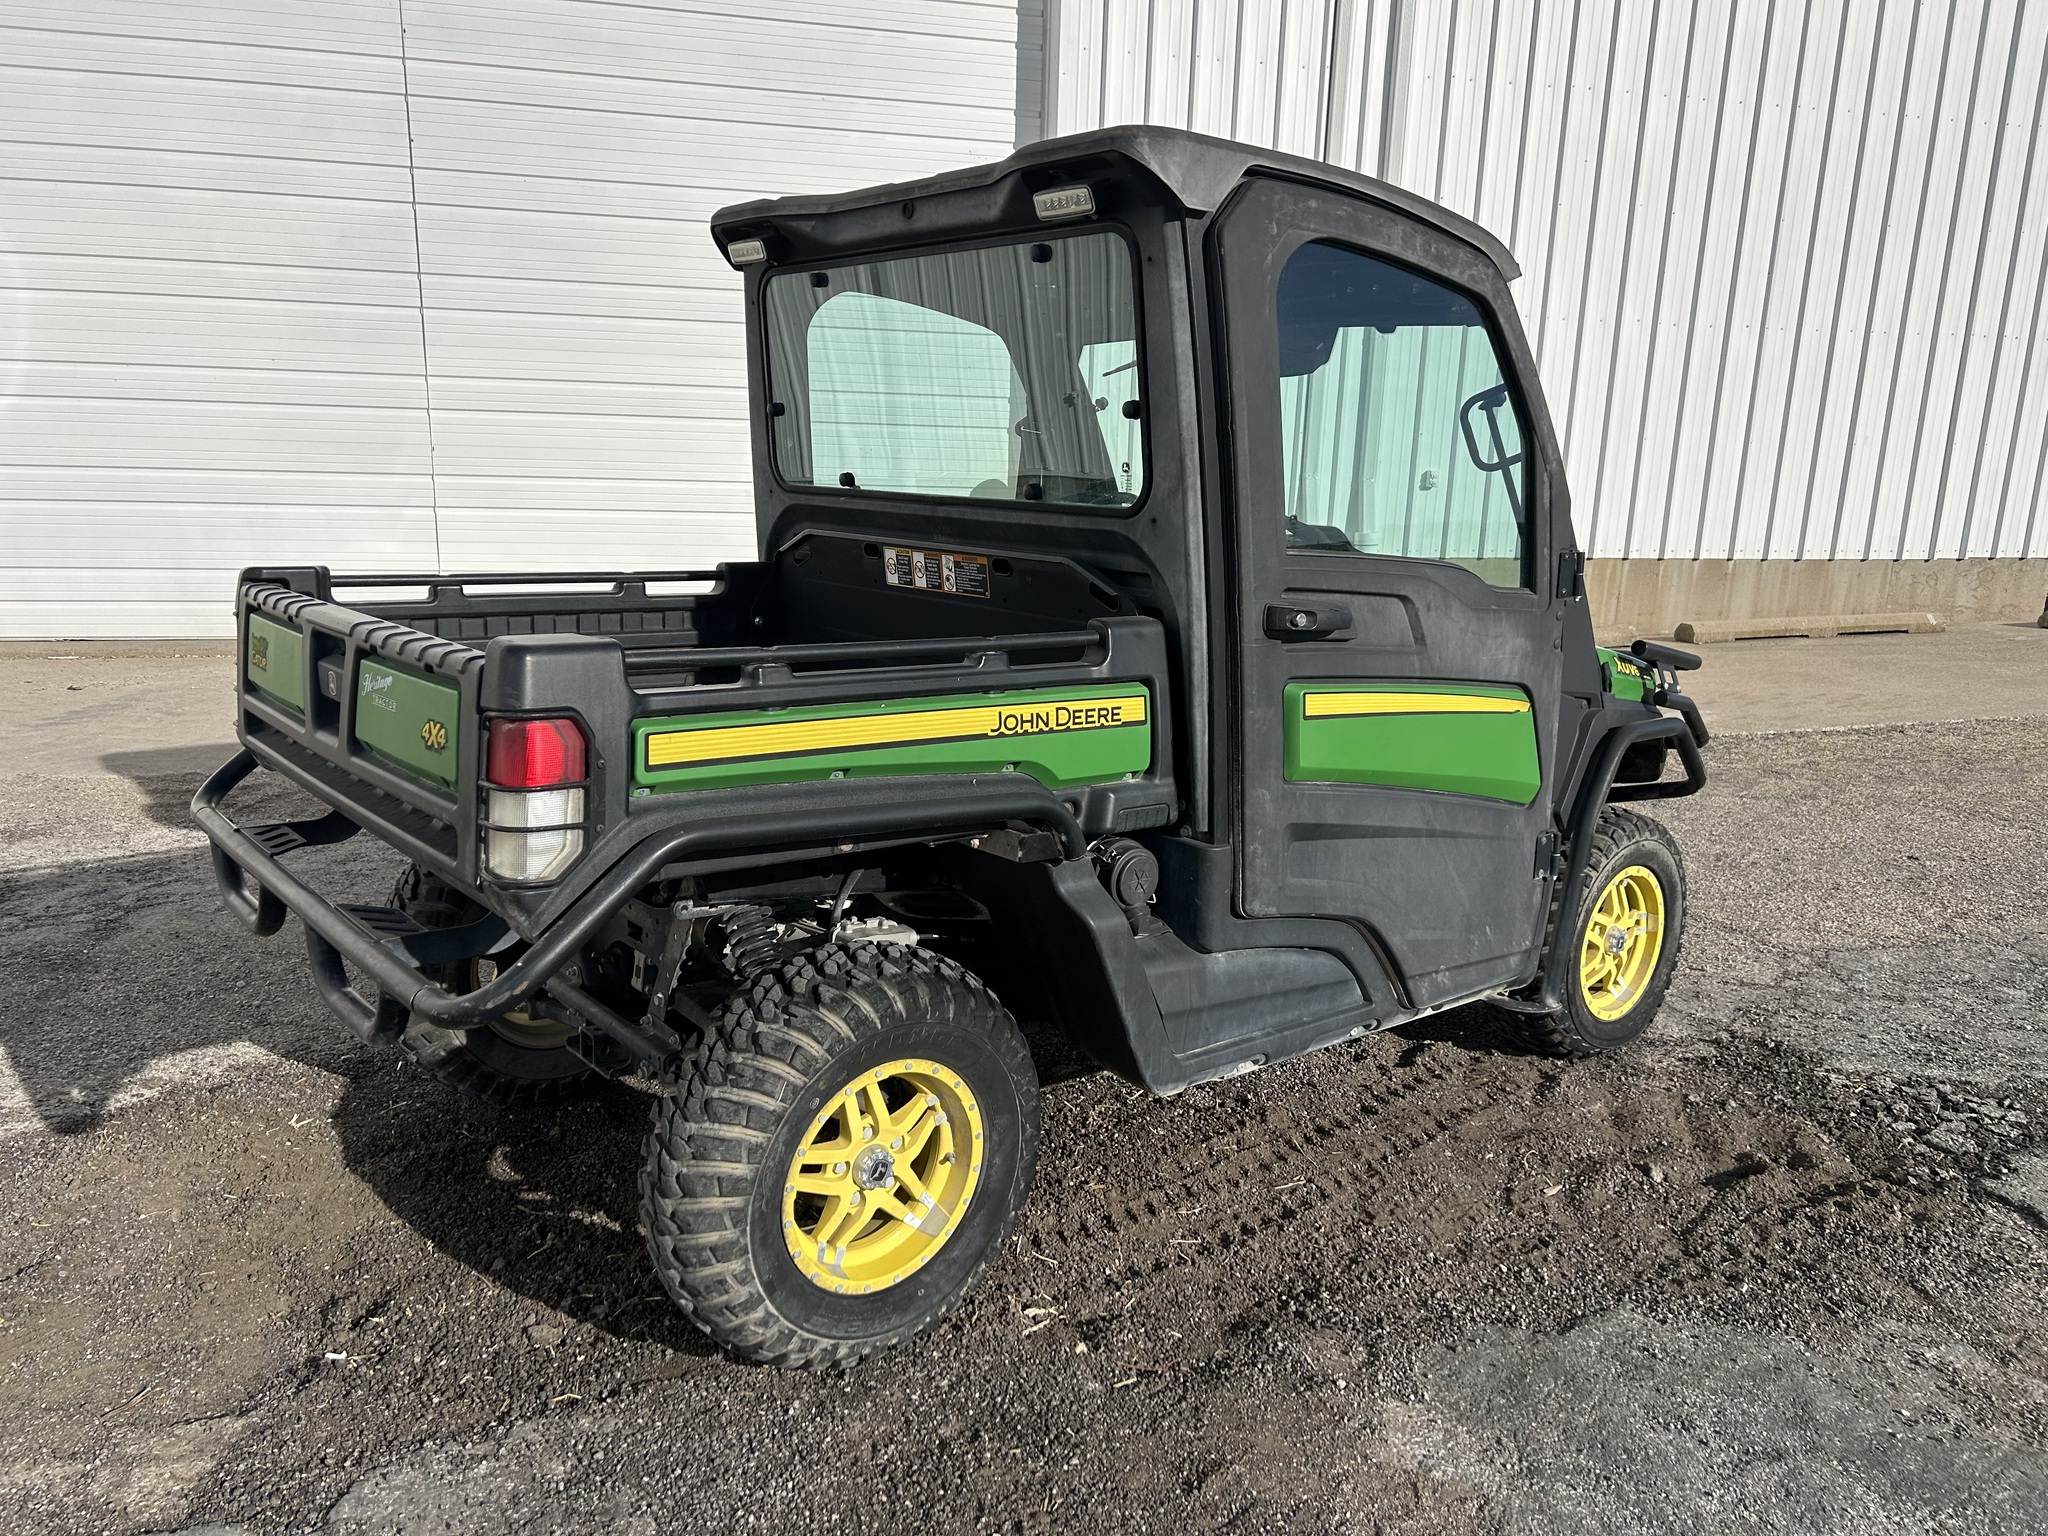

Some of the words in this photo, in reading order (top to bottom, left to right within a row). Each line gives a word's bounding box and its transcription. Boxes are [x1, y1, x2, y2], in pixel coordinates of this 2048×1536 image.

[362, 672, 393, 696] Heritage
[372, 694, 397, 710] TRACTOR
[990, 711, 1050, 733] JOHN
[1055, 706, 1122, 727] DEERE
[422, 720, 447, 749] 4X4
